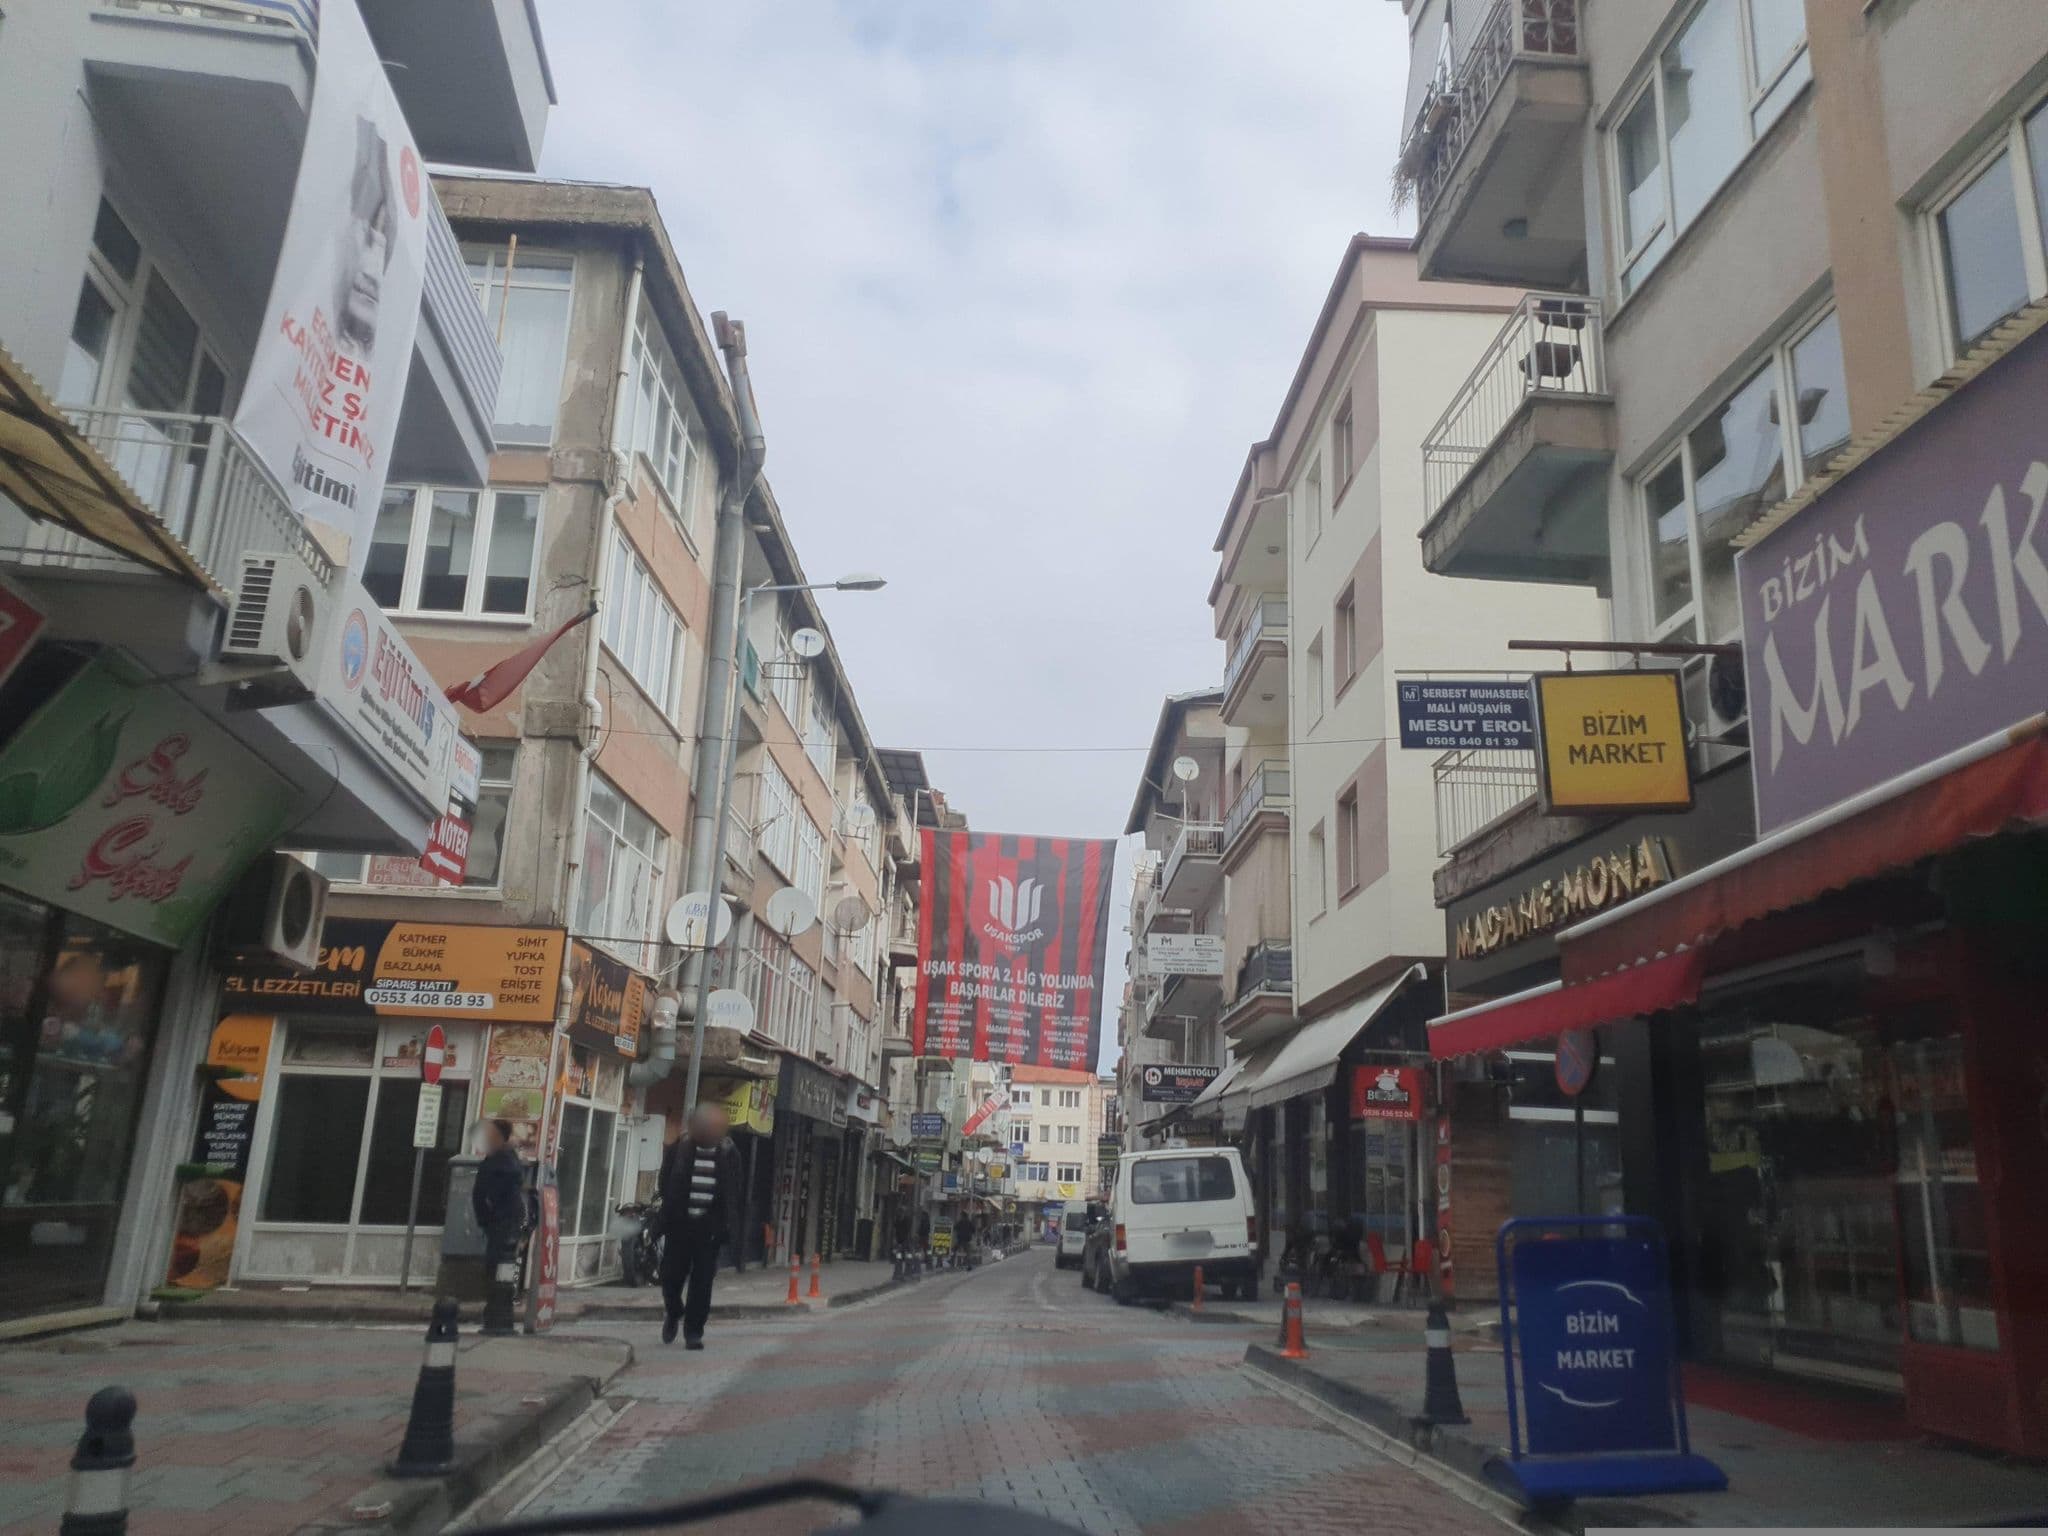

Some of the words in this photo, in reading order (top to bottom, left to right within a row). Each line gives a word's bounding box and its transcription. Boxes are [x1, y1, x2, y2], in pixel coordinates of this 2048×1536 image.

[1759, 514, 1869, 622] BİZİM
[1422, 688, 1467, 699] SERBEST
[1427, 702, 1456, 713] MALİ
[1459, 702, 1512, 716] MÜŞAVİR
[1408, 719, 1476, 733] MESUT
[1482, 720, 1532, 733] EROL
[1582, 710, 1647, 736] BİZİM
[1426, 736, 1456, 746] 0505
[1459, 737, 1482, 746] 840
[1485, 737, 1501, 746] 81
[1503, 737, 1519, 746] 39
[1568, 742, 1667, 765] MARKET
[437, 817, 469, 858] NOTER
[398, 933, 447, 945] KATMER
[516, 935, 549, 948] SİMİT
[403, 945, 445, 959] BÜKME
[506, 951, 545, 962] YUFKA
[383, 961, 442, 973] BAZLAMA
[513, 965, 543, 976] TOST
[923, 960, 955, 977] UŞAK
[959, 965, 1000, 981] SPOR'A
[1003, 968, 1014, 982] 2.
[1017, 969, 1036, 986] LİG
[1040, 974, 1094, 989] YOLUNDA
[252, 977, 360, 997] LEZZETLERİ
[376, 978, 417, 992] SİPARİŞ
[419, 980, 452, 991] HATTI
[369, 992, 406, 1005] 0553
[410, 993, 440, 1006] 408
[444, 994, 466, 1006] 68
[467, 994, 485, 1007] 93
[499, 993, 540, 1005] EKMEK
[951, 981, 1016, 1002] BAŞARILAR
[1019, 989, 1065, 1009] DİLERİZ
[1164, 1067, 1217, 1077] MEHMETOĞLU
[1566, 1310, 1619, 1334] BİZİM
[1557, 1349, 1635, 1369] MARKET
